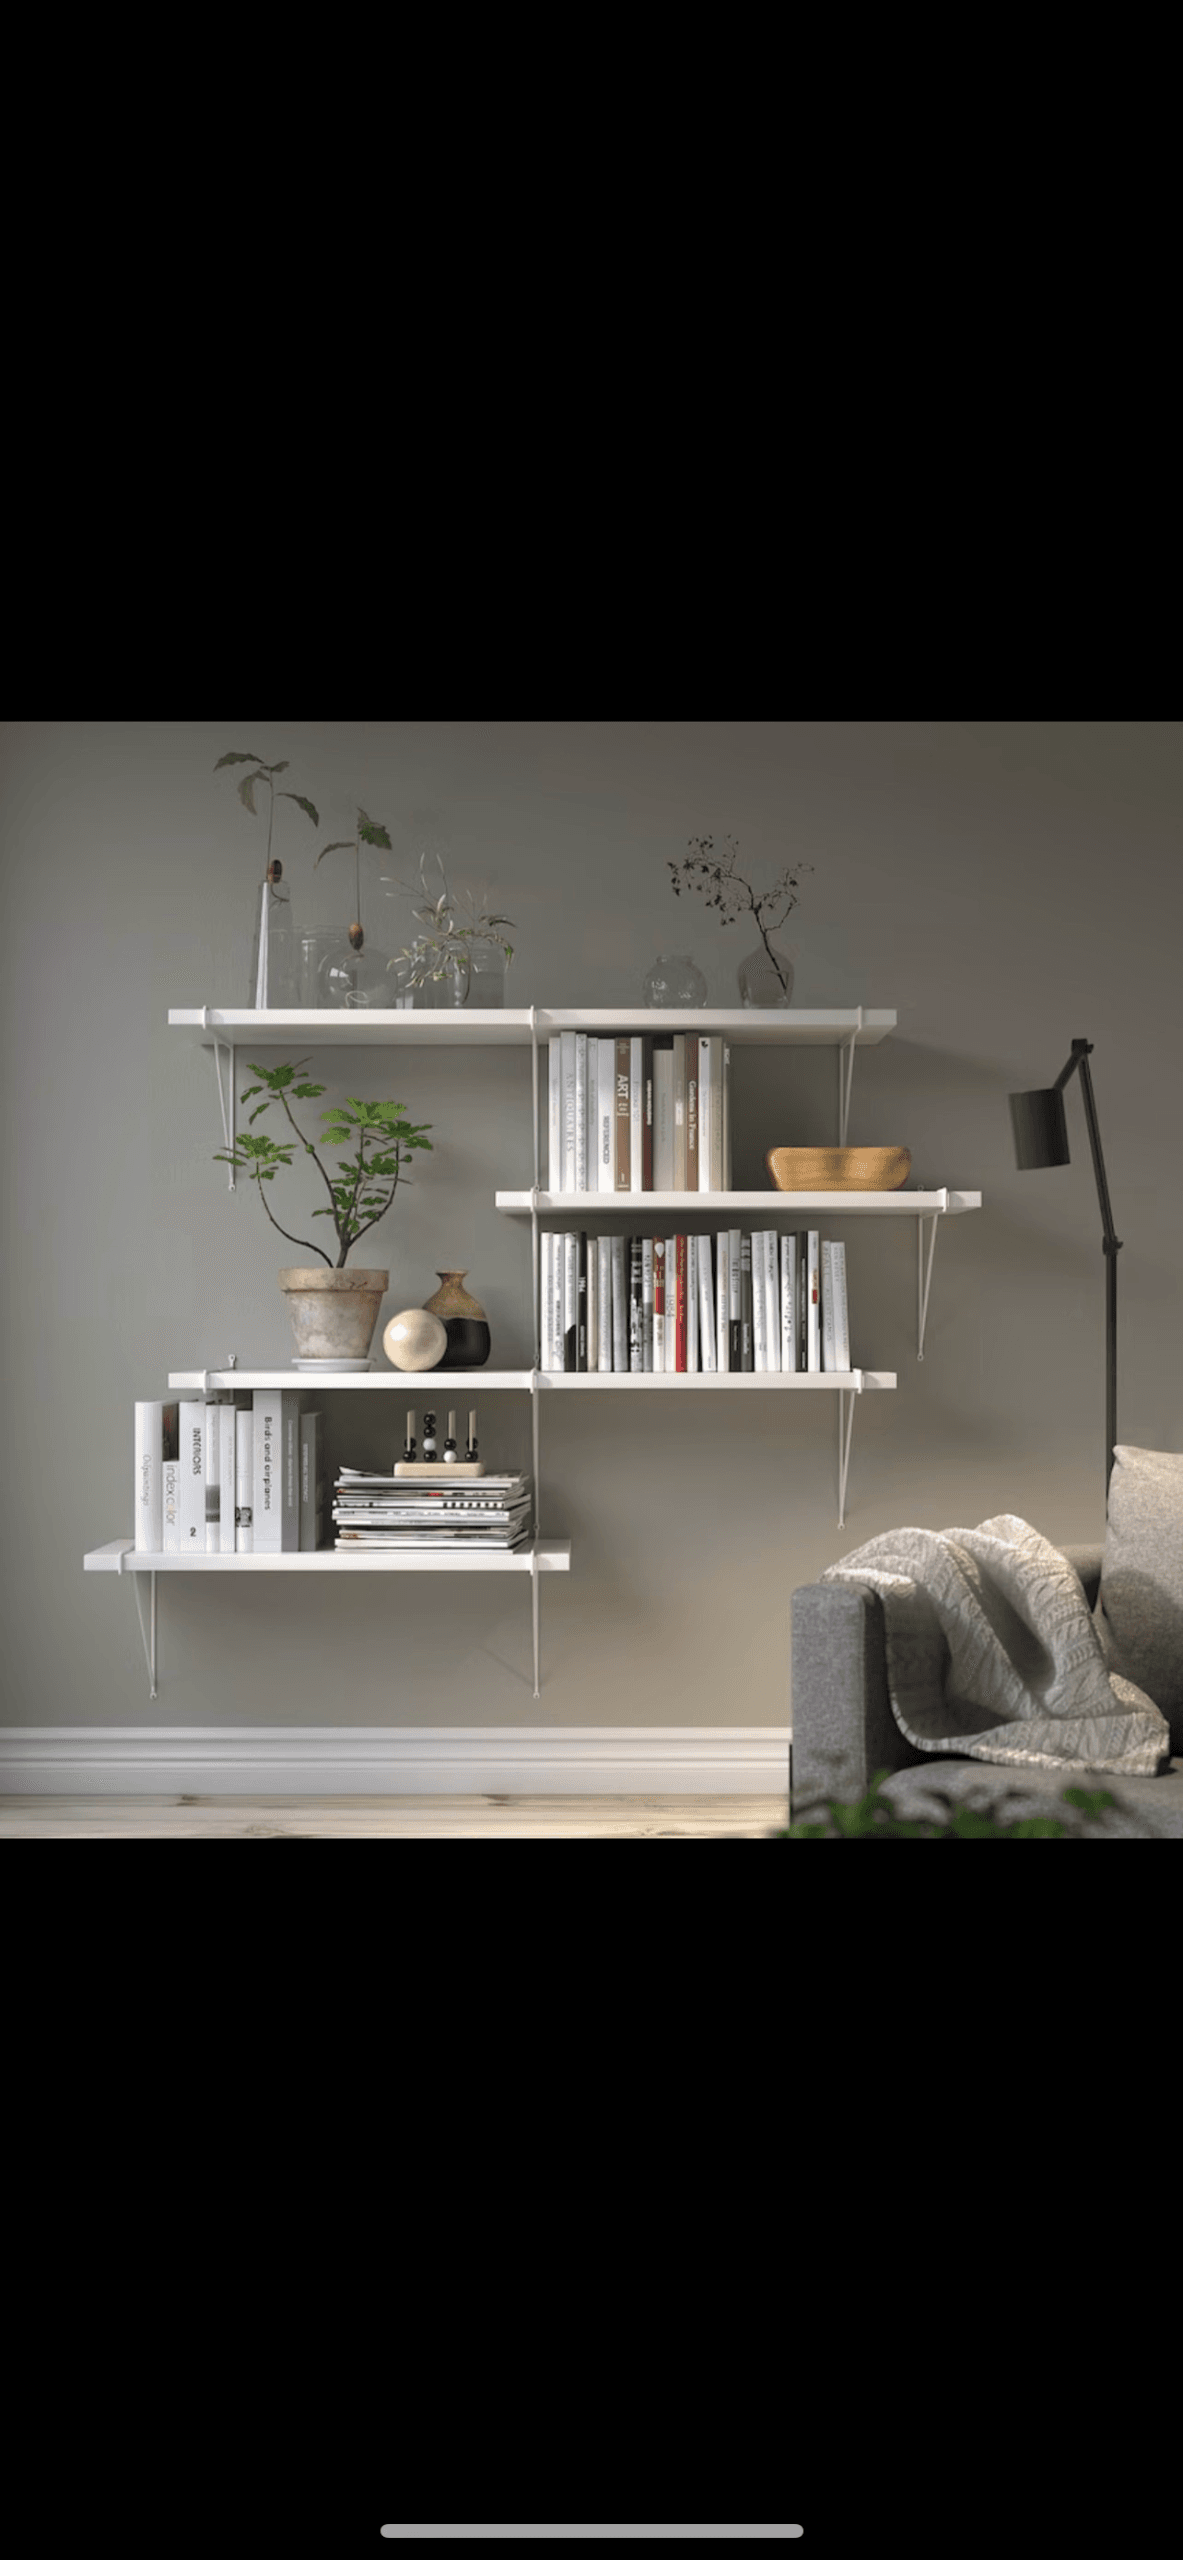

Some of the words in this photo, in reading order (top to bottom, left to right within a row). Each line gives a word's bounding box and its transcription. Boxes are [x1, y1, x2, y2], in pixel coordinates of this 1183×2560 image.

[618, 1074, 628, 1099] ART
[689, 1114, 696, 1122] in
[264, 1417, 272, 1440] Birds
[193, 1428, 201, 1475] INTERIORS
[263, 1465, 272, 1510] airplanes
[190, 1527, 196, 1537] 2
